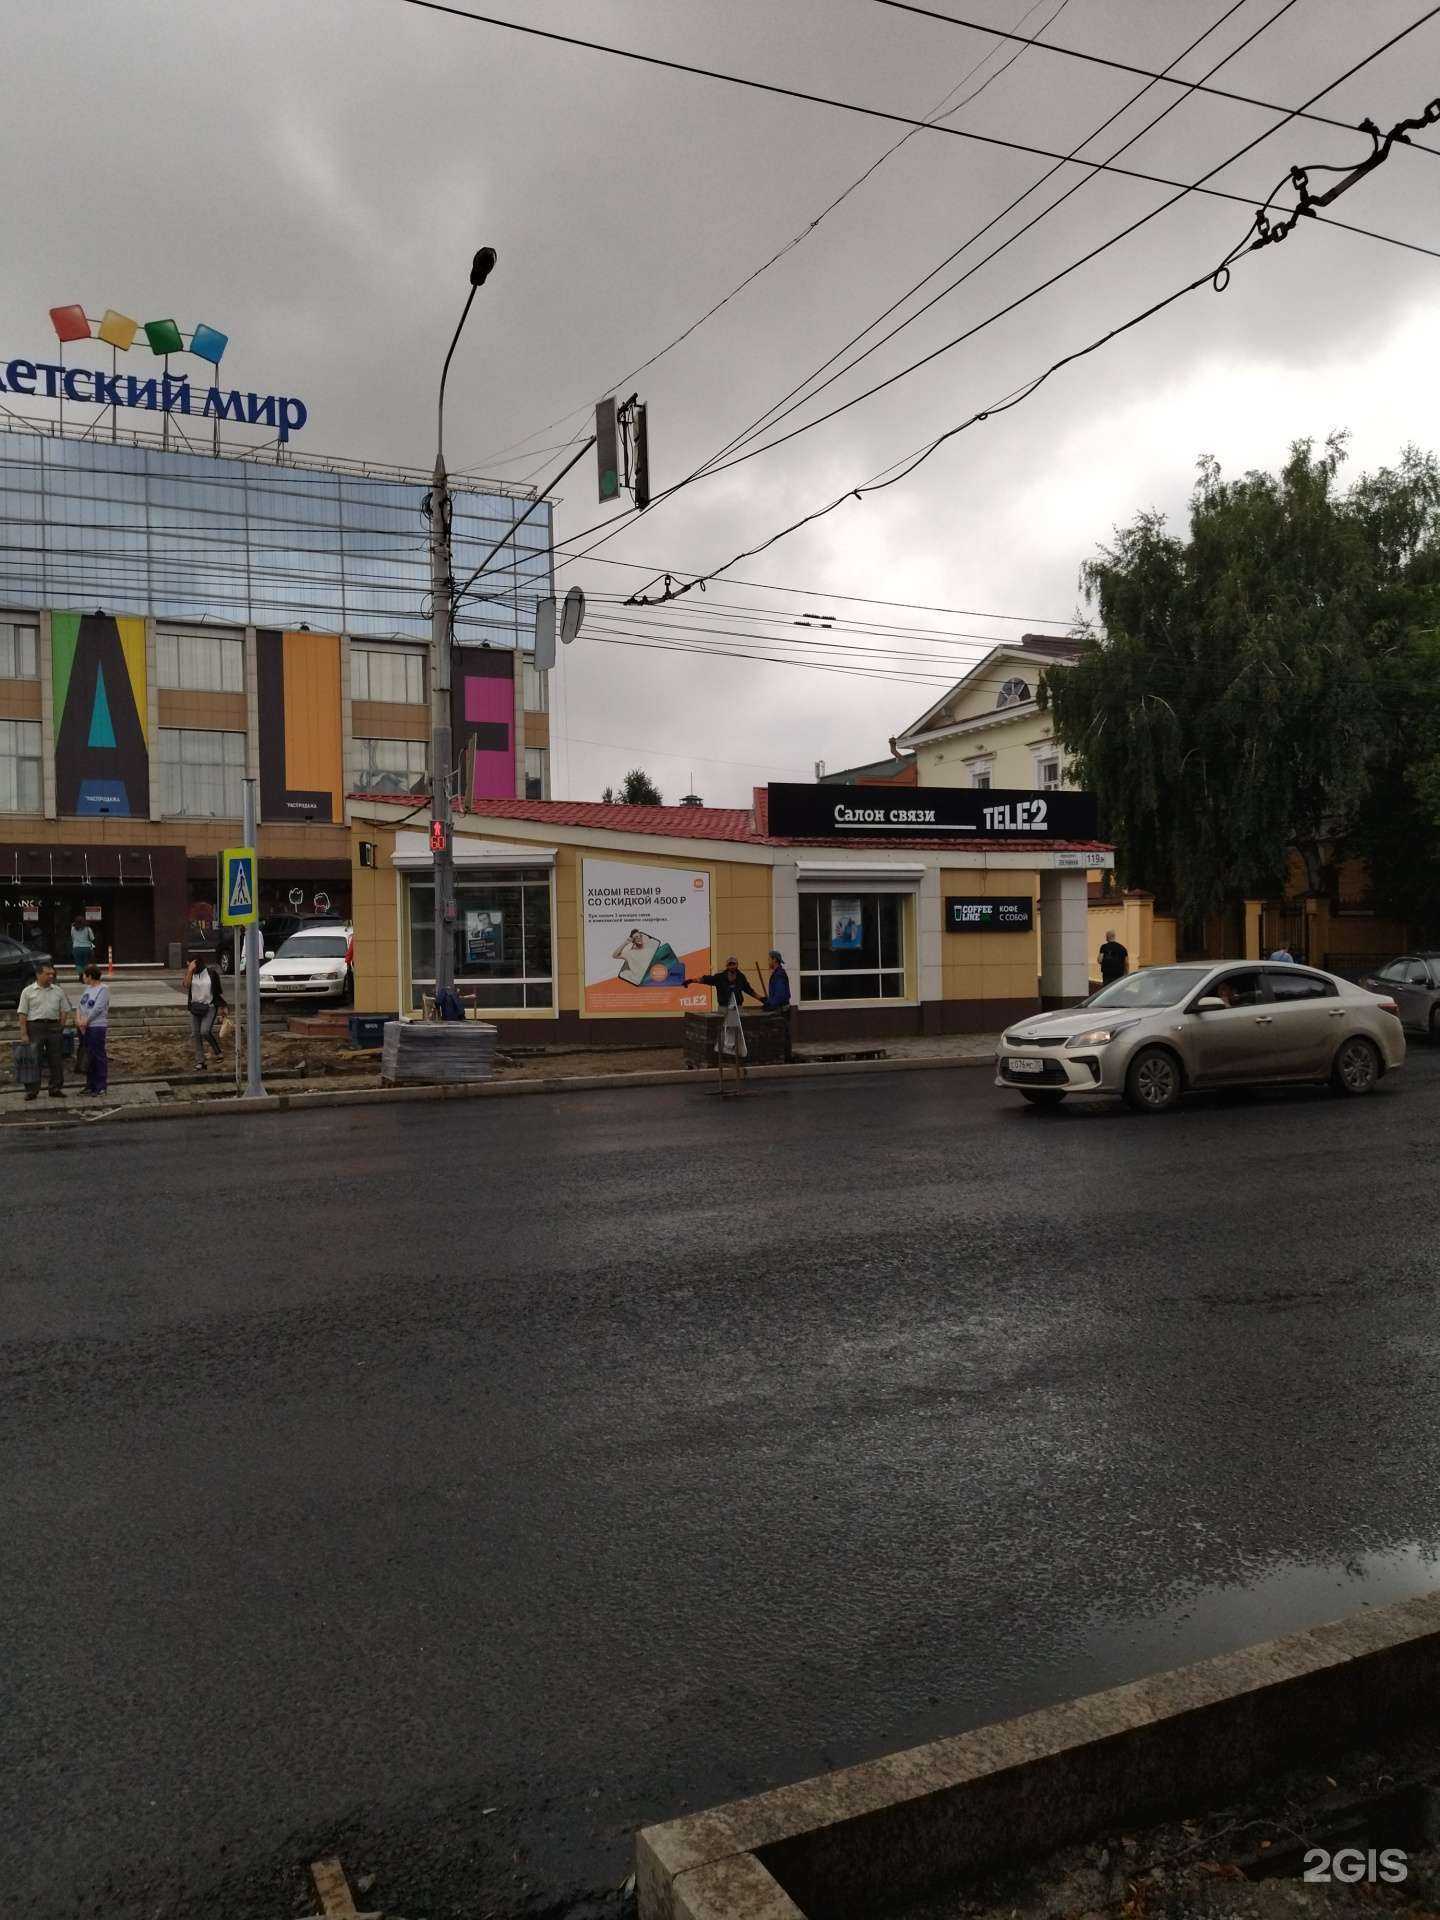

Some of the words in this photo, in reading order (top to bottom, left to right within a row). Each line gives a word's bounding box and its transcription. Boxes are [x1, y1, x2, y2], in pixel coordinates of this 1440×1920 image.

[202, 386, 308, 442] мир
[834, 804, 885, 822] Салон
[889, 810, 936, 822] связи
[983, 799, 1048, 831] TELE2
[588, 888, 621, 896] XIAOMI
[623, 888, 653, 896] REDMI
[655, 887, 661, 895] 9
[588, 898, 602, 906] СО
[604, 896, 652, 907] СКИДКОЙ
[653, 897, 678, 905] 4500
[962, 905, 993, 914] COFFEE
[1005, 912, 1029, 921] СОБОЙ
[680, 994, 707, 1007] TELE2
